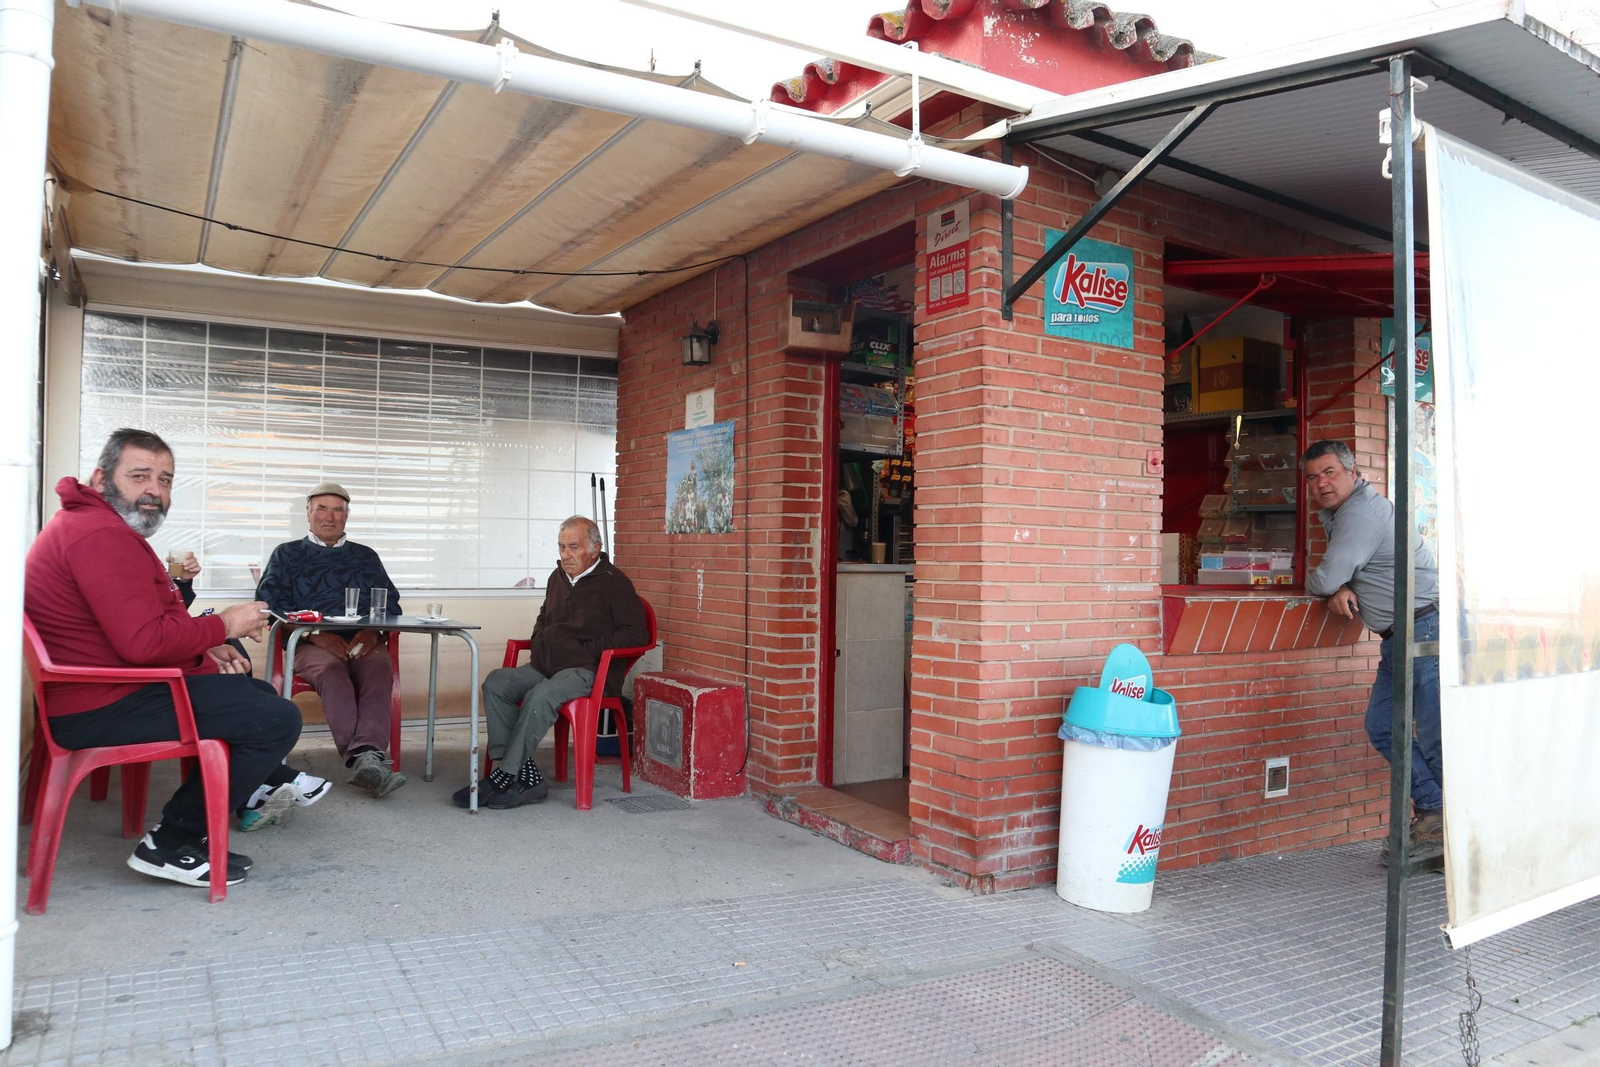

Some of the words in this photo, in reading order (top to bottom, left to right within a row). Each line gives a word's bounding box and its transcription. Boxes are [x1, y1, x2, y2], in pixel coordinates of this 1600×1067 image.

[934, 220, 963, 247] Direct
[930, 248, 965, 269] Alarma
[1061, 254, 1128, 308] Kalise
[1051, 313, 1072, 323] para
[1074, 313, 1099, 323] todos
